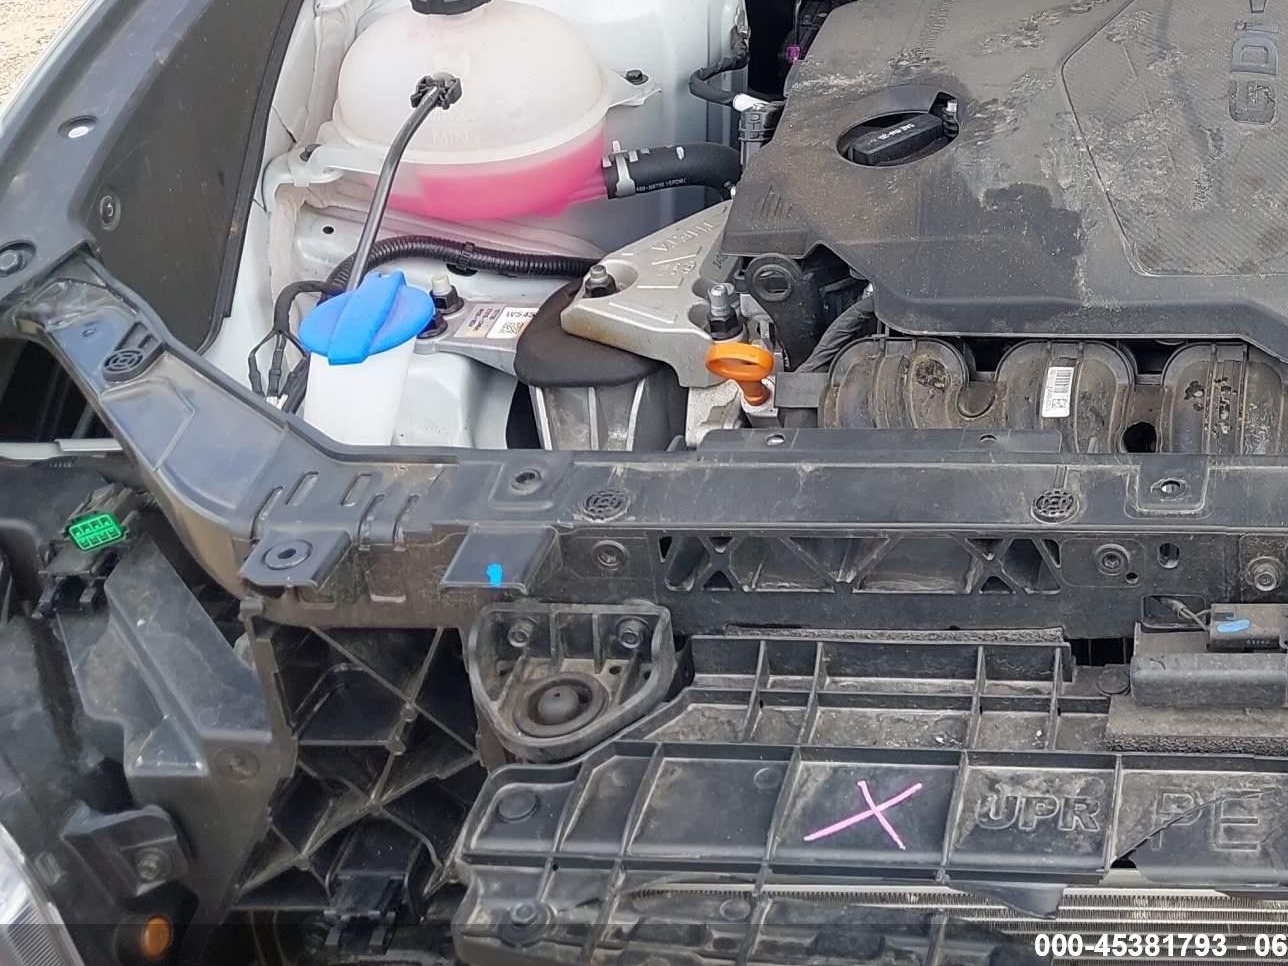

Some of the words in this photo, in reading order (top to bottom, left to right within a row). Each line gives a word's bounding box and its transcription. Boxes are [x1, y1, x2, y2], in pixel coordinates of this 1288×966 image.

[1228, 20, 1279, 122] GDI
[976, 792, 1100, 832] UPR
[1152, 787, 1264, 852] PE
